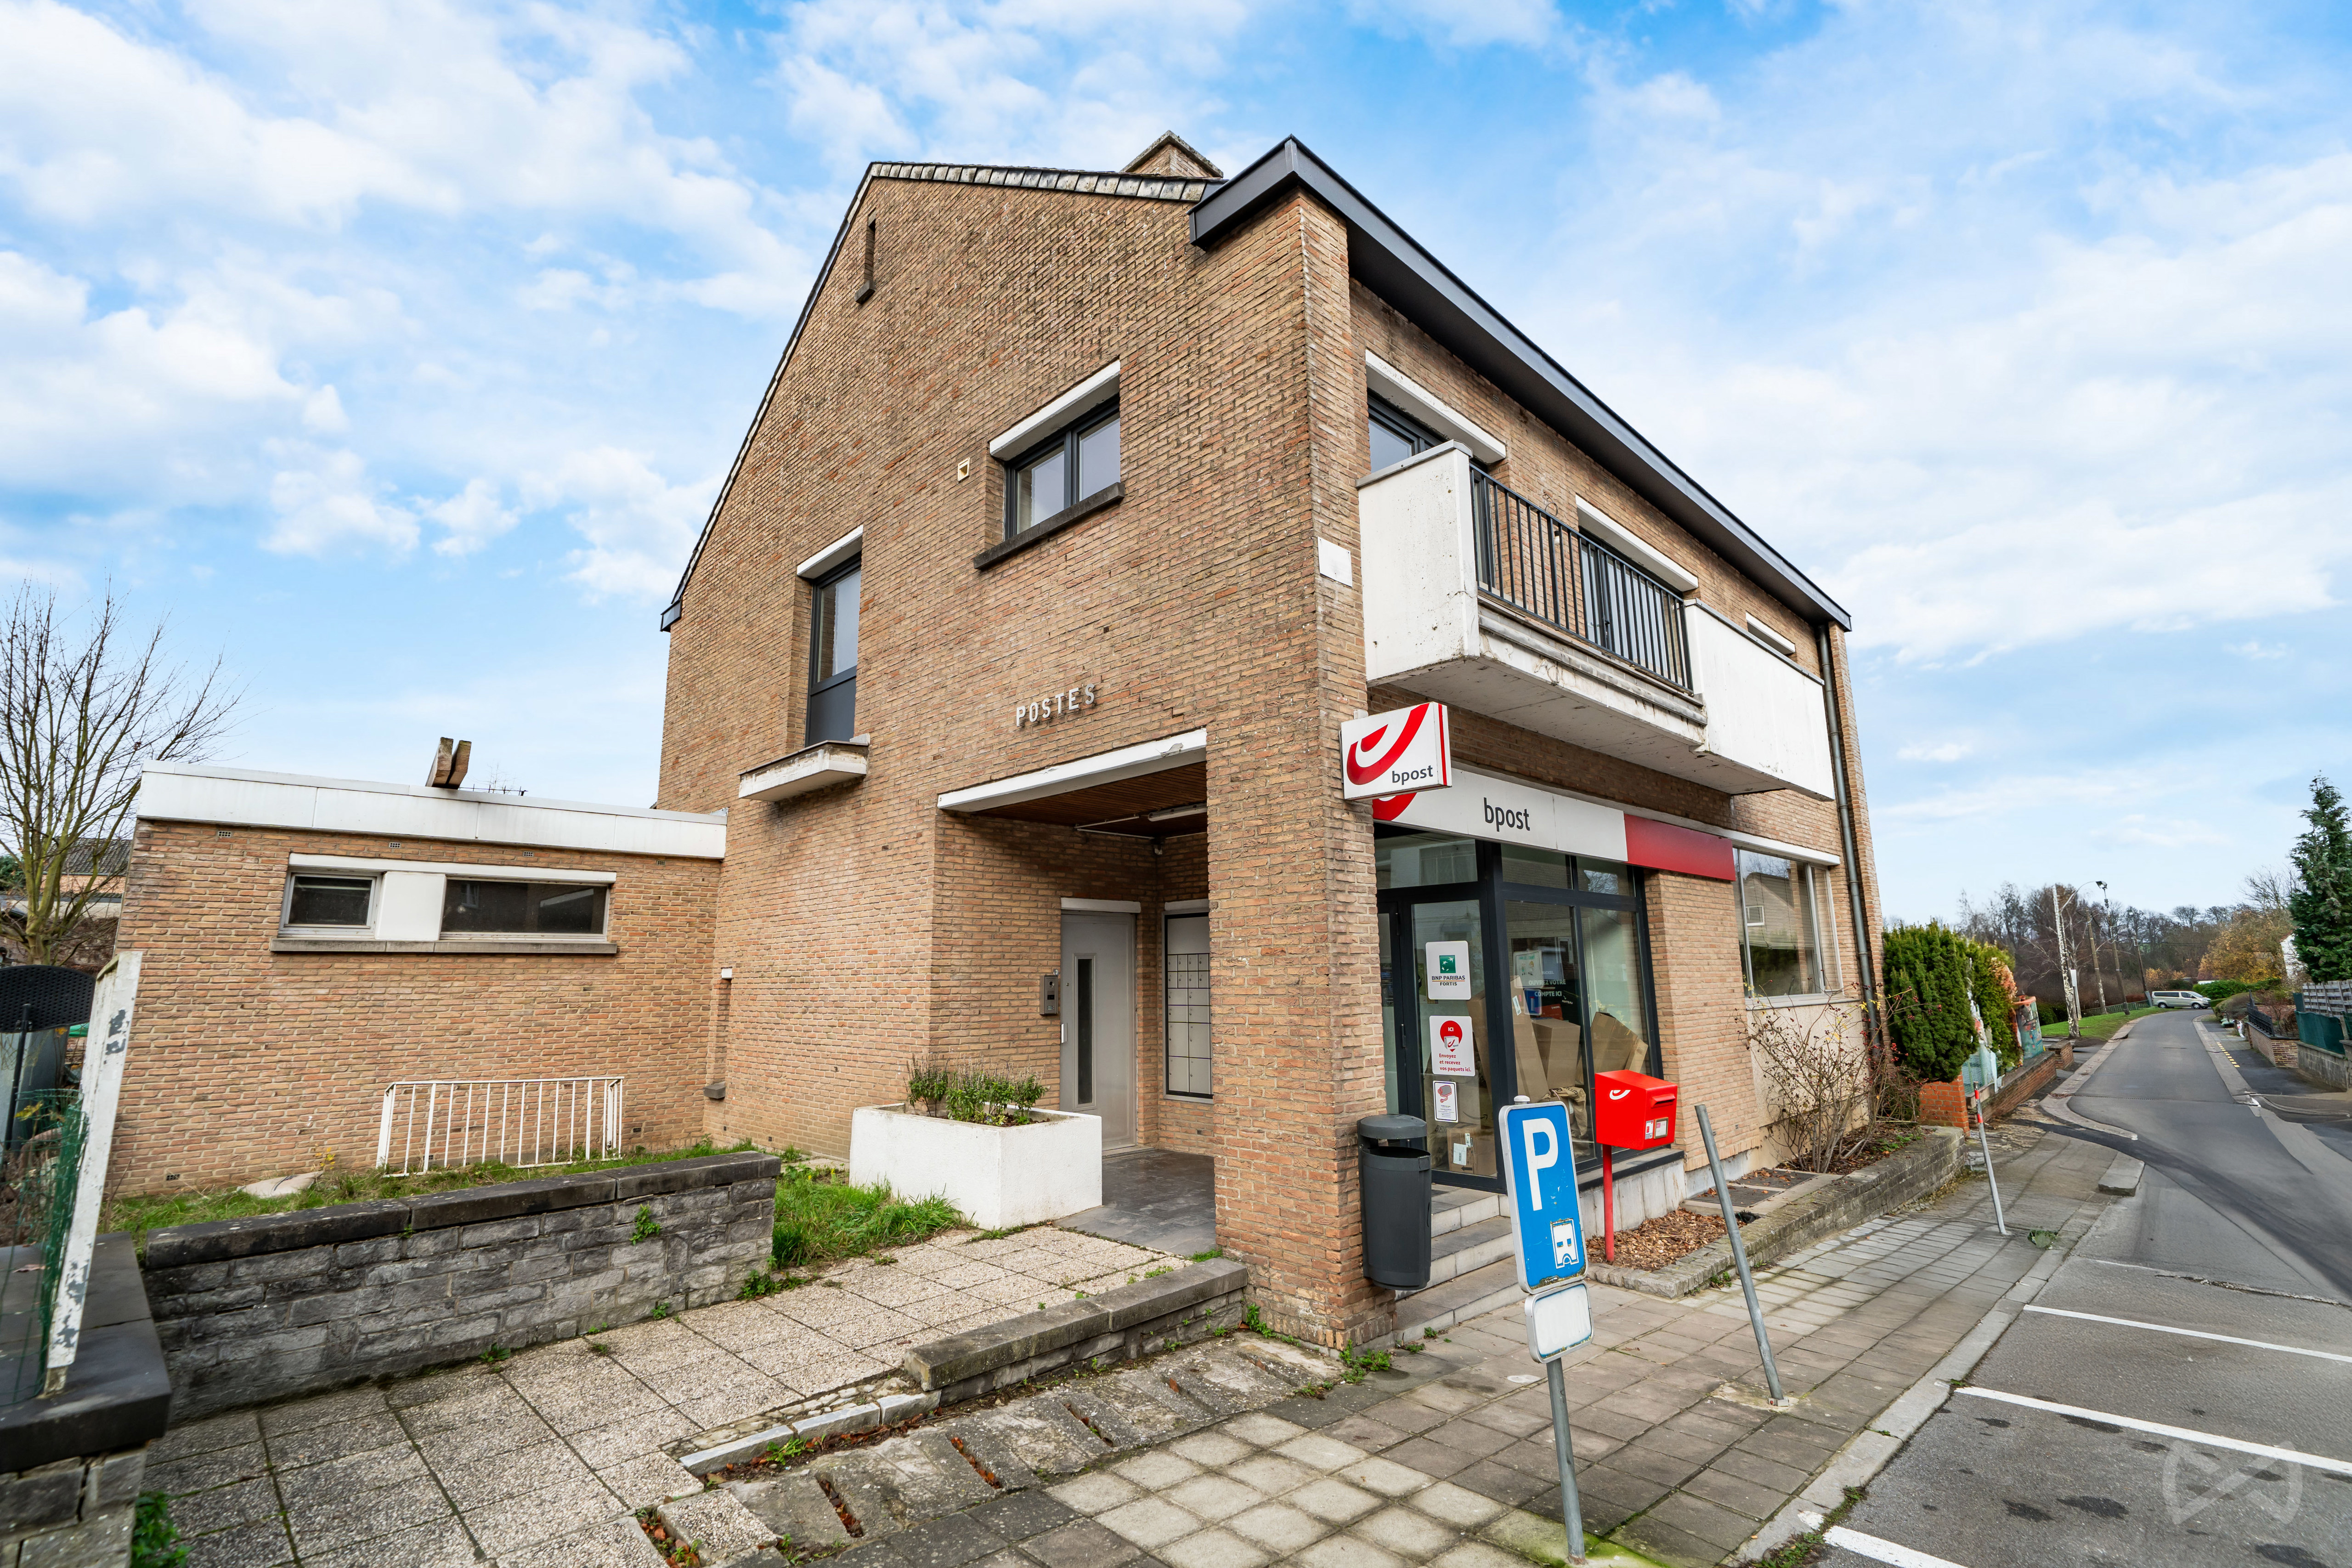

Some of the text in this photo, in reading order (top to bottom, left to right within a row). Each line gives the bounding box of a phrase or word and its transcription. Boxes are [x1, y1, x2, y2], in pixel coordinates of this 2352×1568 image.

[1016, 683, 1095, 727] POSTES
[1392, 765, 1433, 785] bpost
[1483, 797, 1530, 832] bpost
[1522, 1118, 1559, 1211] P
